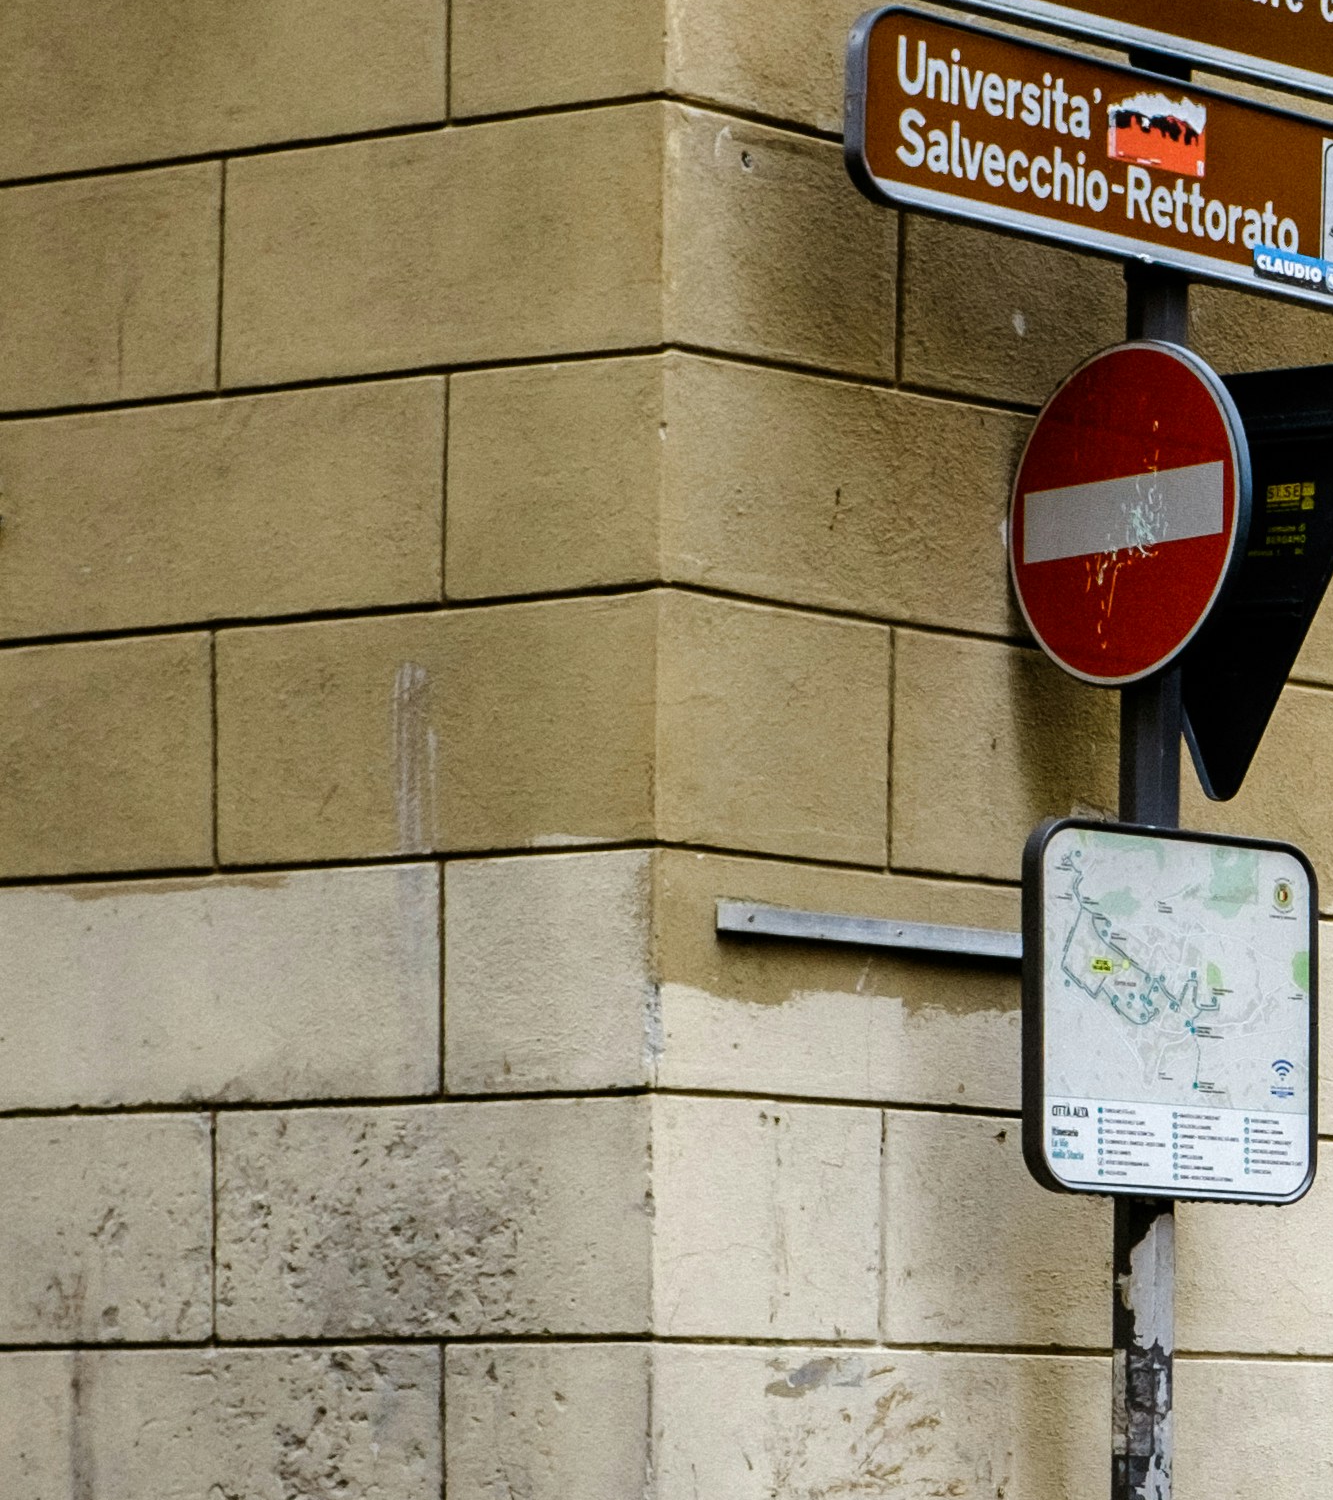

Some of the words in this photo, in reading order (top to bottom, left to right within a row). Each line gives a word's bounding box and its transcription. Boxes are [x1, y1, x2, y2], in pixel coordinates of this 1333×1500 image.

[896, 34, 1101, 140] Universita'
[895, 107, 1299, 255] Salvecchio-Rettorato
[1256, 253, 1323, 284] CLAUDIO
